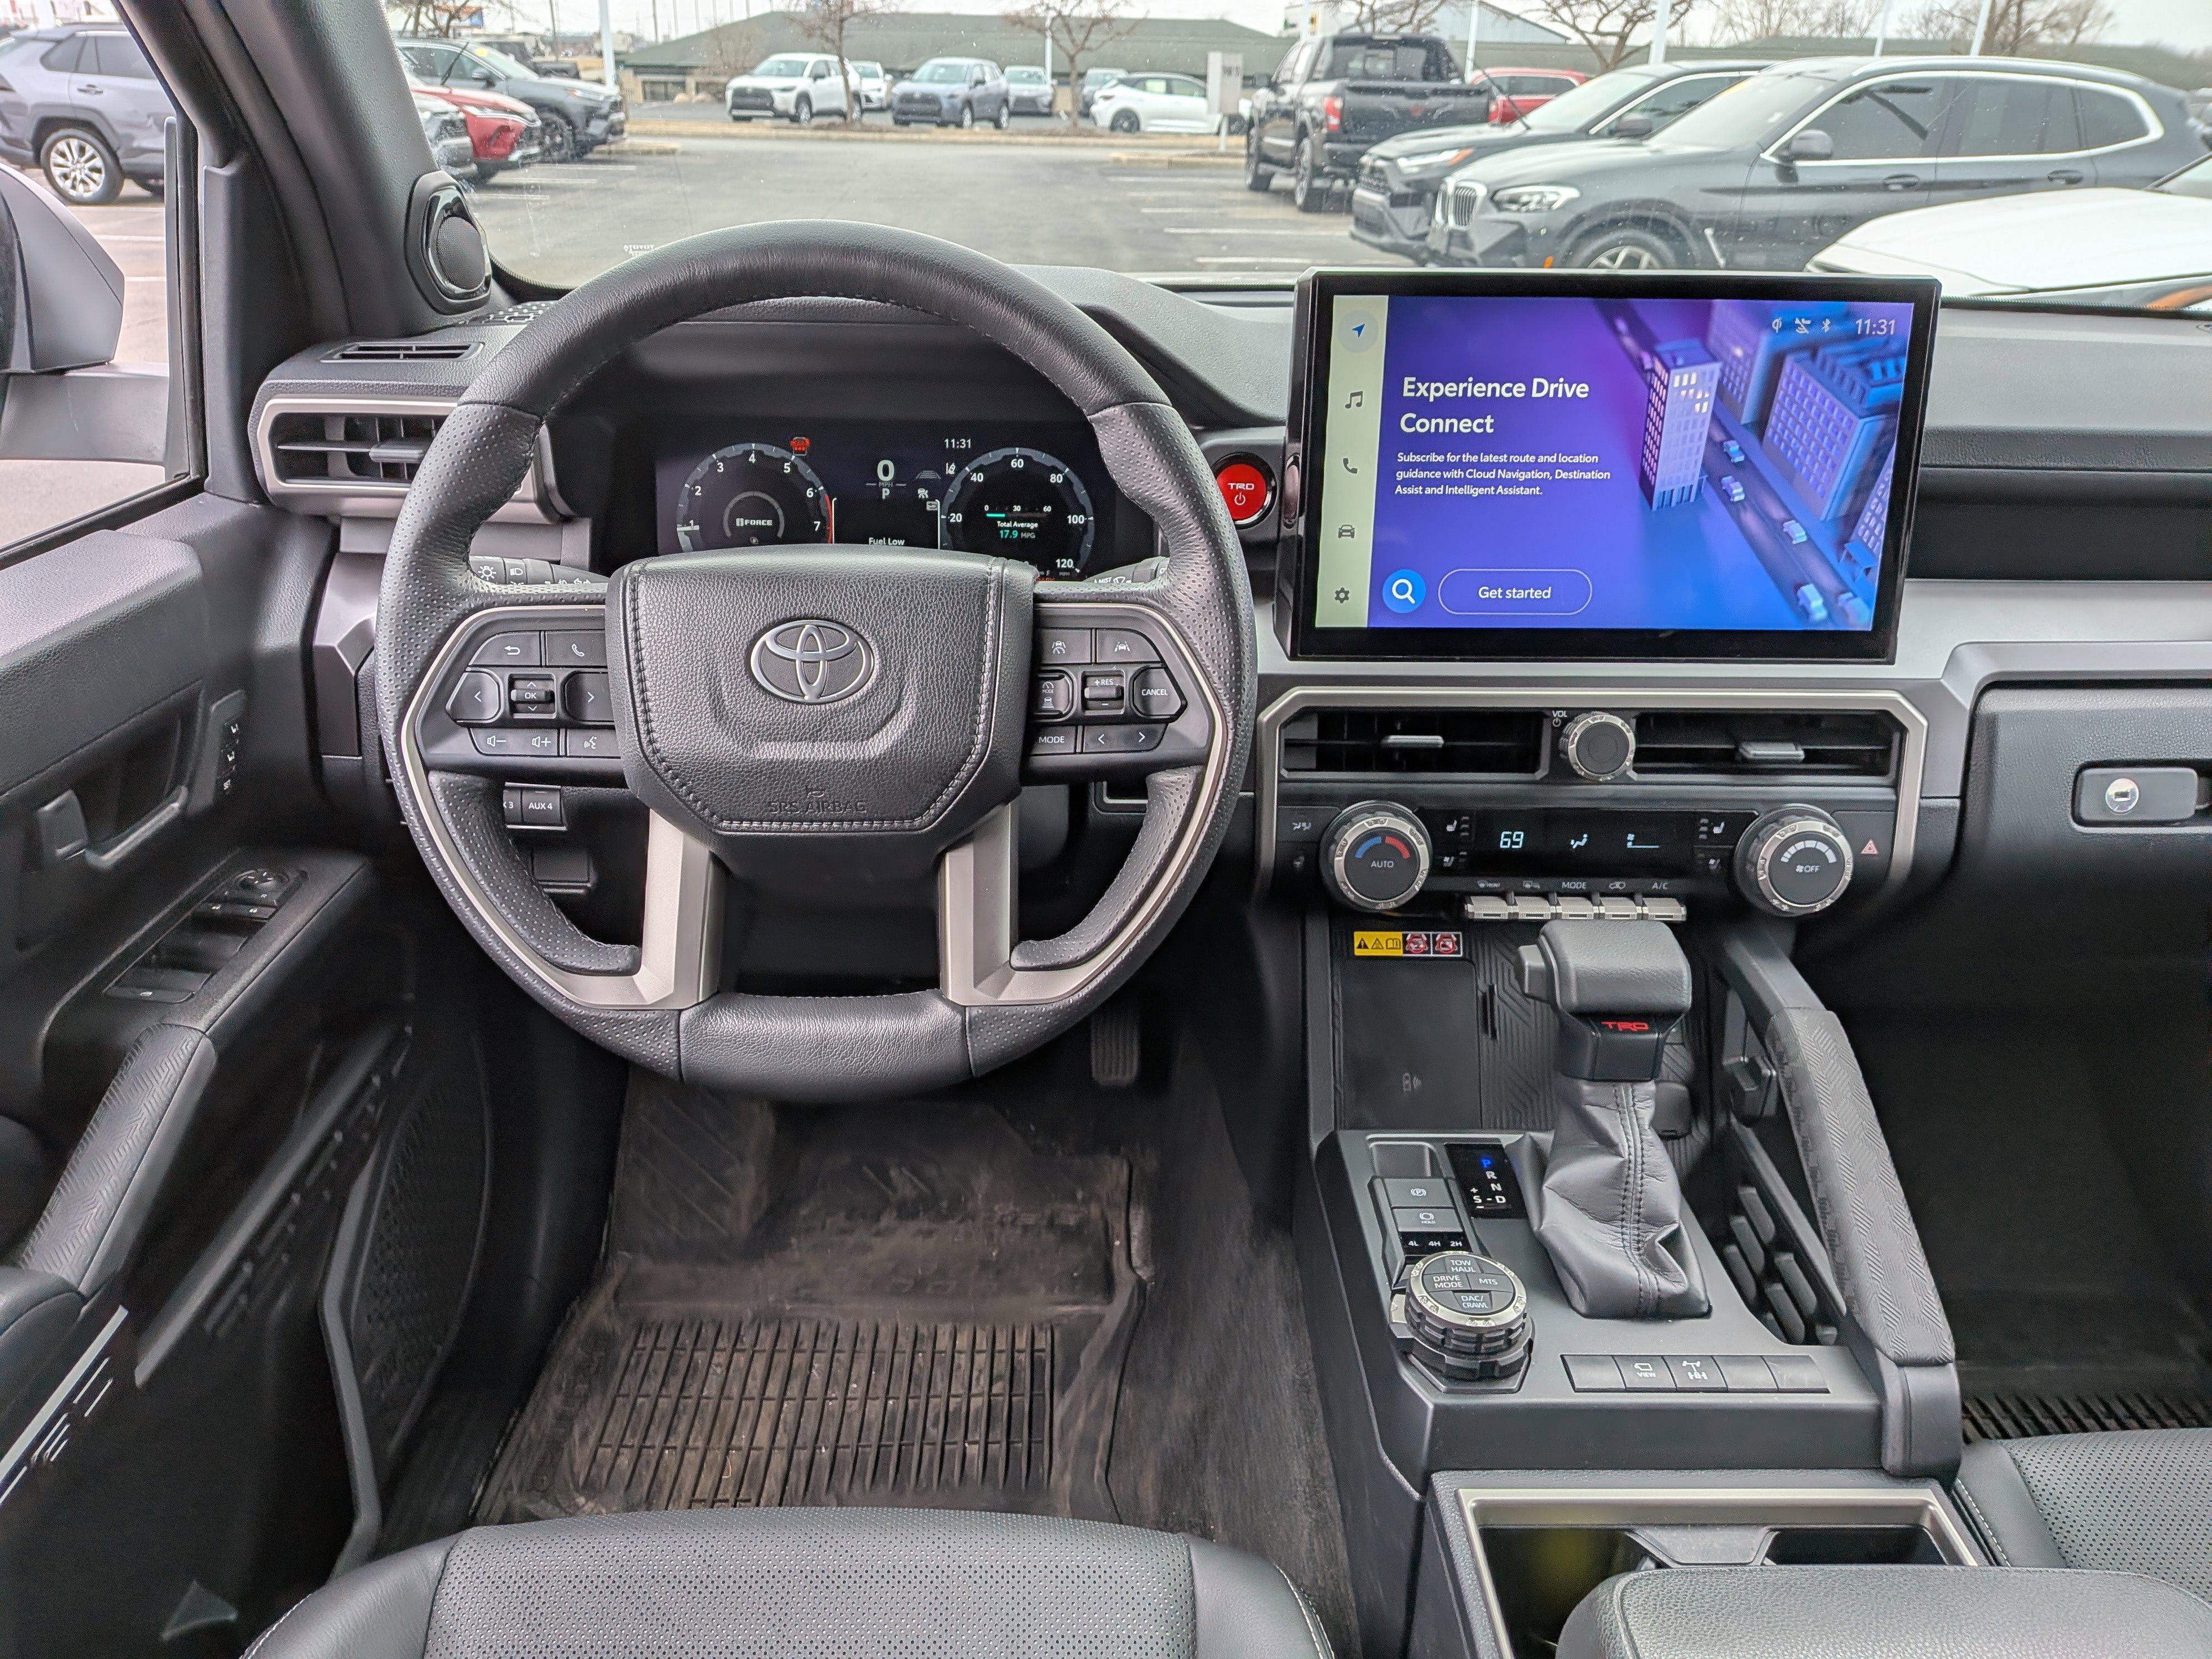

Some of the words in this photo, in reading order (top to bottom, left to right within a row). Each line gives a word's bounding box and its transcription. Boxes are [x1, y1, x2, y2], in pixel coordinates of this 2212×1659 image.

[1856, 318, 1896, 335] 11:31
[1402, 376, 1526, 403] Experience
[1532, 377, 1589, 398] Drive
[1400, 413, 1494, 434] Connect
[944, 439, 972, 448] 11:31
[748, 453, 756, 463] 4
[1397, 452, 1444, 463] Subscribe
[1447, 452, 1461, 463] for
[1462, 452, 1479, 463] the
[1480, 452, 1508, 463] latest
[1509, 454, 1536, 463] route
[1537, 453, 1557, 463] and
[1558, 453, 1599, 463] location
[717, 462, 724, 472] 3
[783, 462, 791, 473] 5
[1011, 458, 1024, 468] 60
[877, 460, 895, 482] 0
[1396, 468, 1442, 481] guidance
[1443, 468, 1464, 479] with
[1465, 468, 1494, 479] Cloud
[1497, 469, 1552, 481] Navigation,
[1554, 469, 1611, 480] Destination
[970, 472, 984, 482] 40
[1050, 473, 1063, 483] 80
[695, 486, 702, 496] 2
[806, 488, 813, 498] 6
[882, 488, 890, 500] P
[1395, 484, 1423, 494] Assist
[1425, 484, 1444, 494] and
[1445, 485, 1495, 497] Intelligent
[1496, 485, 1543, 495] Assistant.
[950, 513, 962, 523] 20
[1067, 514, 1085, 524] 100
[688, 519, 694, 530] 1
[813, 521, 821, 531] 7
[999, 530, 1018, 539] 17.9
[868, 537, 886, 545] Fuel
[888, 538, 905, 546] Low
[1055, 559, 1073, 568] 120
[1478, 586, 1503, 599] Get
[1505, 586, 1552, 599] started
[1039, 735, 1065, 744] MODE
[770, 802, 800, 814] SRS
[805, 802, 867, 814] AIRBAG
[1499, 831, 1524, 848] 69
[1370, 860, 1394, 868] AUTO
[1562, 881, 1587, 889] MODE
[1652, 882, 1669, 890] A/C
[1600, 1020, 1649, 1031] TRD
[1481, 1159, 1491, 1168] P
[1485, 1171, 1498, 1180] R
[1490, 1183, 1503, 1191] N
[1473, 1195, 1483, 1203] S
[1495, 1195, 1506, 1203] D
